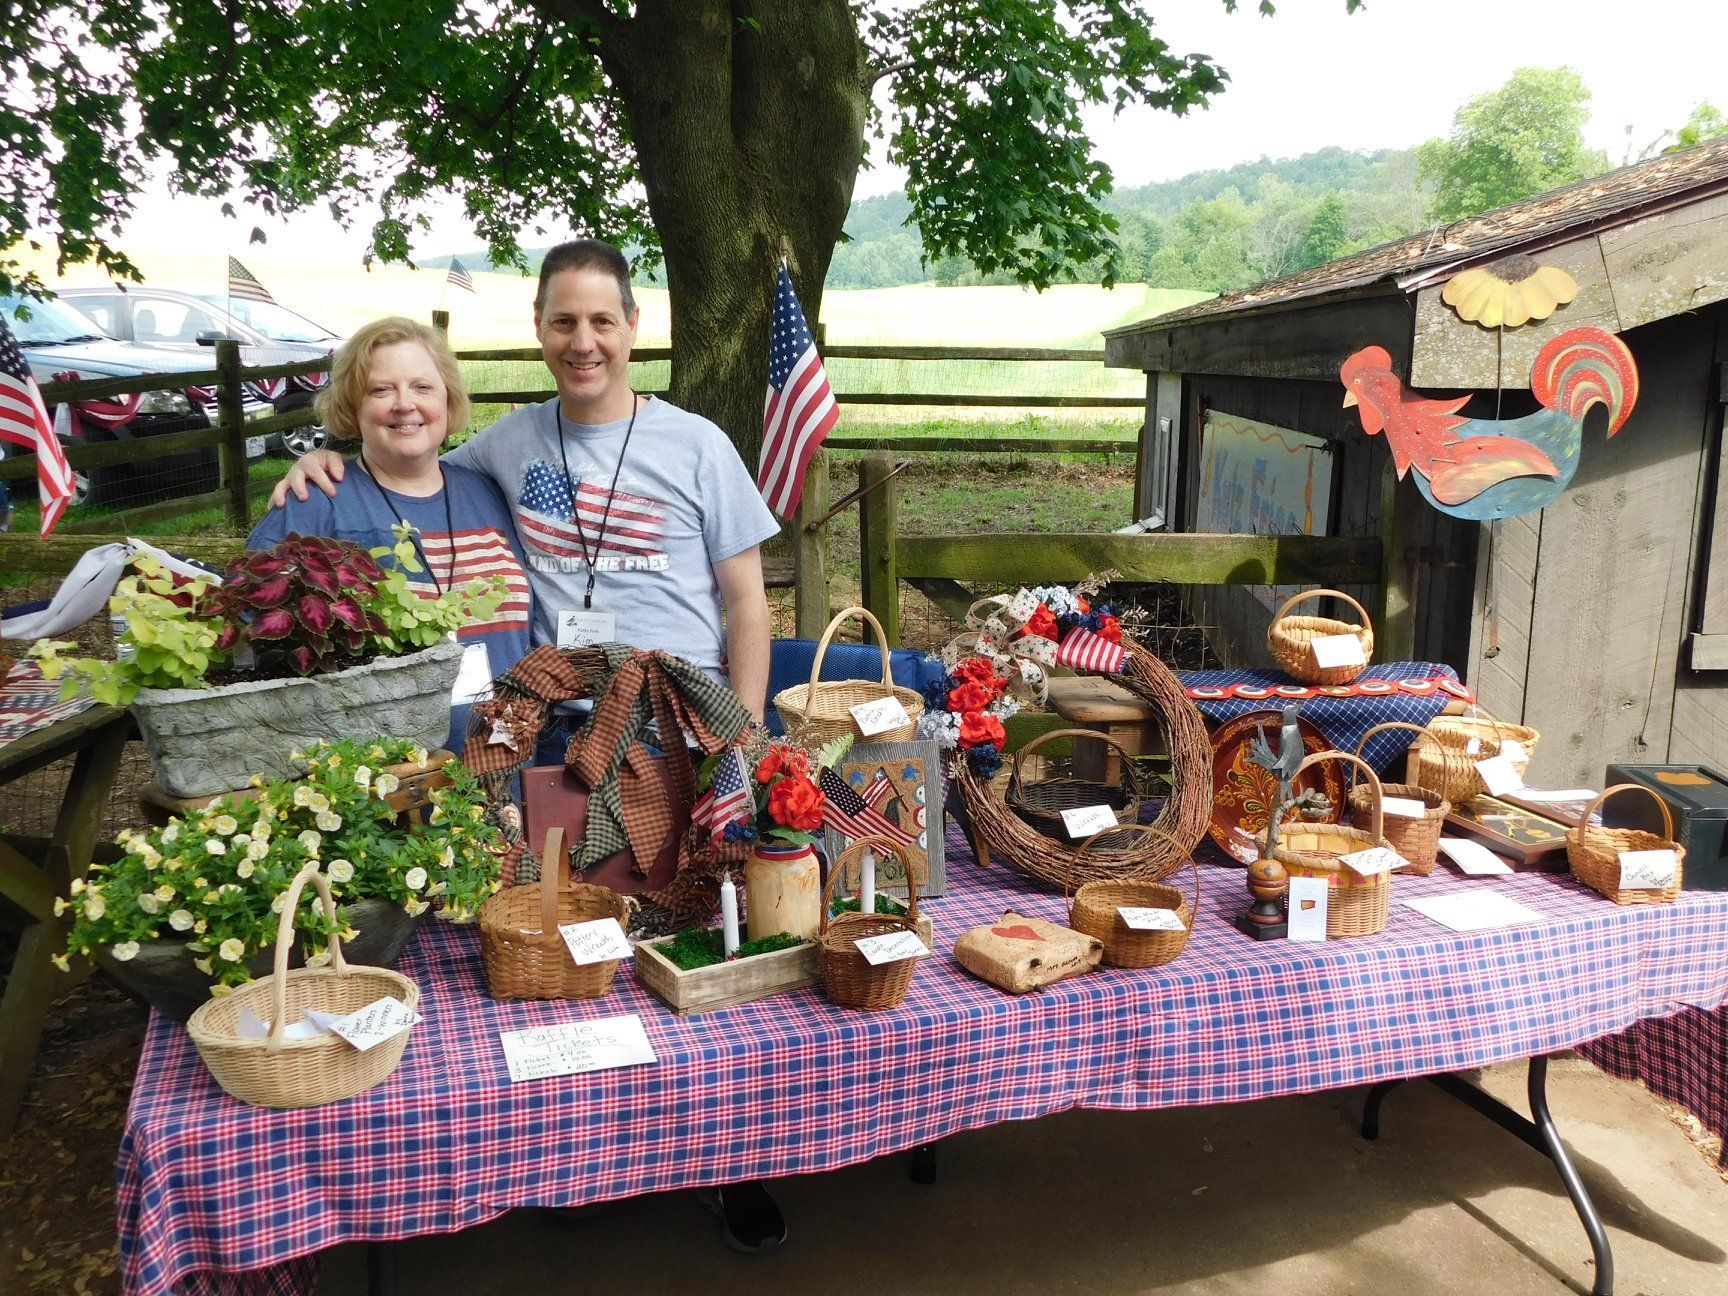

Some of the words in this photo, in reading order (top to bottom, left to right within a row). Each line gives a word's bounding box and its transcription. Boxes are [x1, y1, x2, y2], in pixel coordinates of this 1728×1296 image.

[559, 556, 581, 573] OF
[624, 553, 670, 572] FREE
[581, 934, 613, 956] Wreath
[516, 1025, 594, 1045] Raffle
[545, 1034, 618, 1053] Tickets
